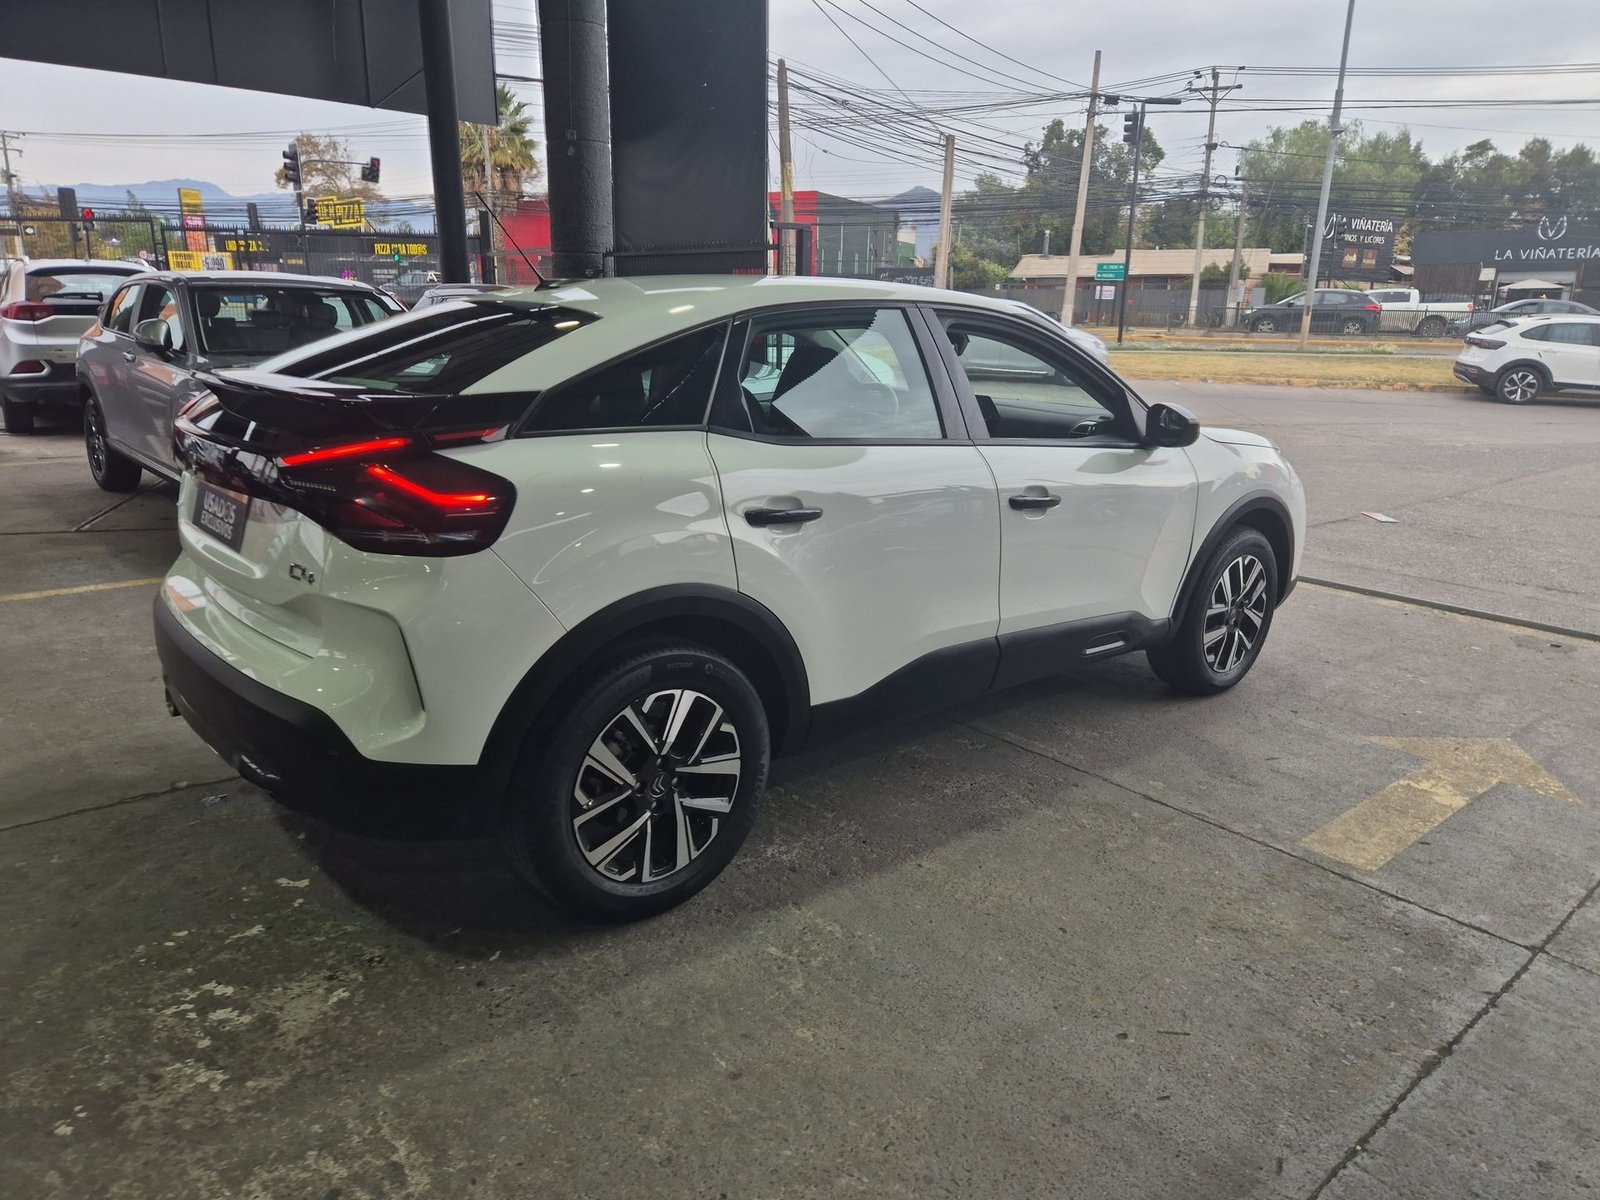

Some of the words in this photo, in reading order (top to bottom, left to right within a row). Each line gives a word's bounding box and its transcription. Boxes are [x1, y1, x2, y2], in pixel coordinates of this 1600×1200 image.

[1351, 217, 1393, 233] VIÑATERÍA
[1364, 235, 1386, 244] LICORES
[374, 243, 391, 255] PIZZA
[1494, 249, 1513, 260] LA
[1520, 245, 1600, 260] VIÑATERÍA
[204, 490, 237, 524] USADOS
[200, 512, 234, 541] EXCLUSIVOS
